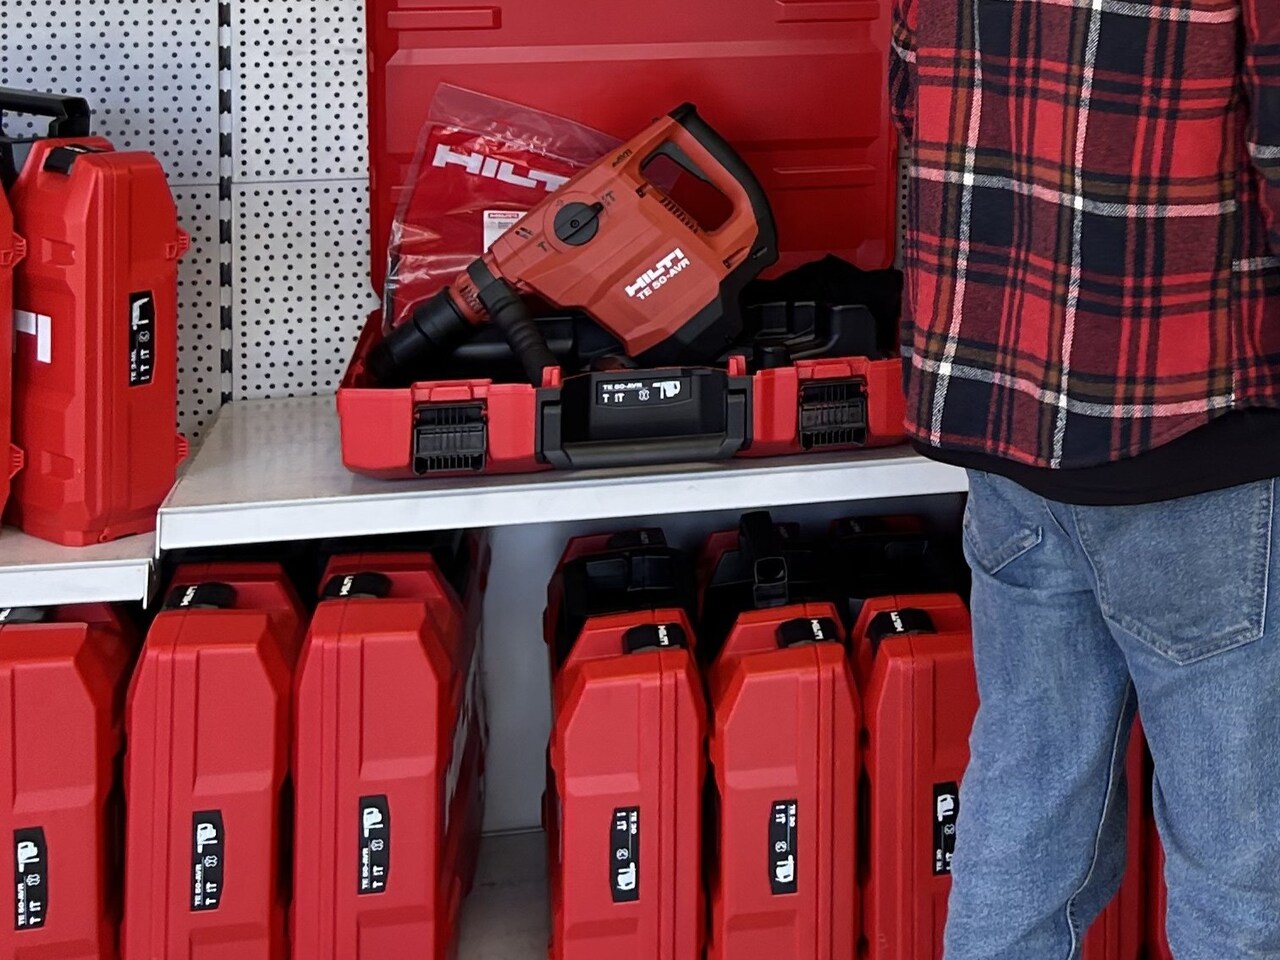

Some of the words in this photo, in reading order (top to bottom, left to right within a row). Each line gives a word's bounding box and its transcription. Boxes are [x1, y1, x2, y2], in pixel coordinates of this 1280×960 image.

[432, 143, 571, 192] HILT
[624, 247, 685, 297] HILTI
[636, 286, 653, 300] TE
[652, 258, 690, 290] 50-AVR
[180, 585, 198, 606] HILTI
[339, 575, 354, 596] HILTI
[810, 619, 824, 640] HILTI
[890, 611, 904, 632] HILTI
[657, 625, 669, 645] HILTI
[631, 811, 637, 822] TE
[789, 804, 796, 815] TE
[936, 861, 943, 872] TE
[362, 878, 369, 890] TE
[194, 894, 201, 907] TE
[17, 914, 25, 926] TE
